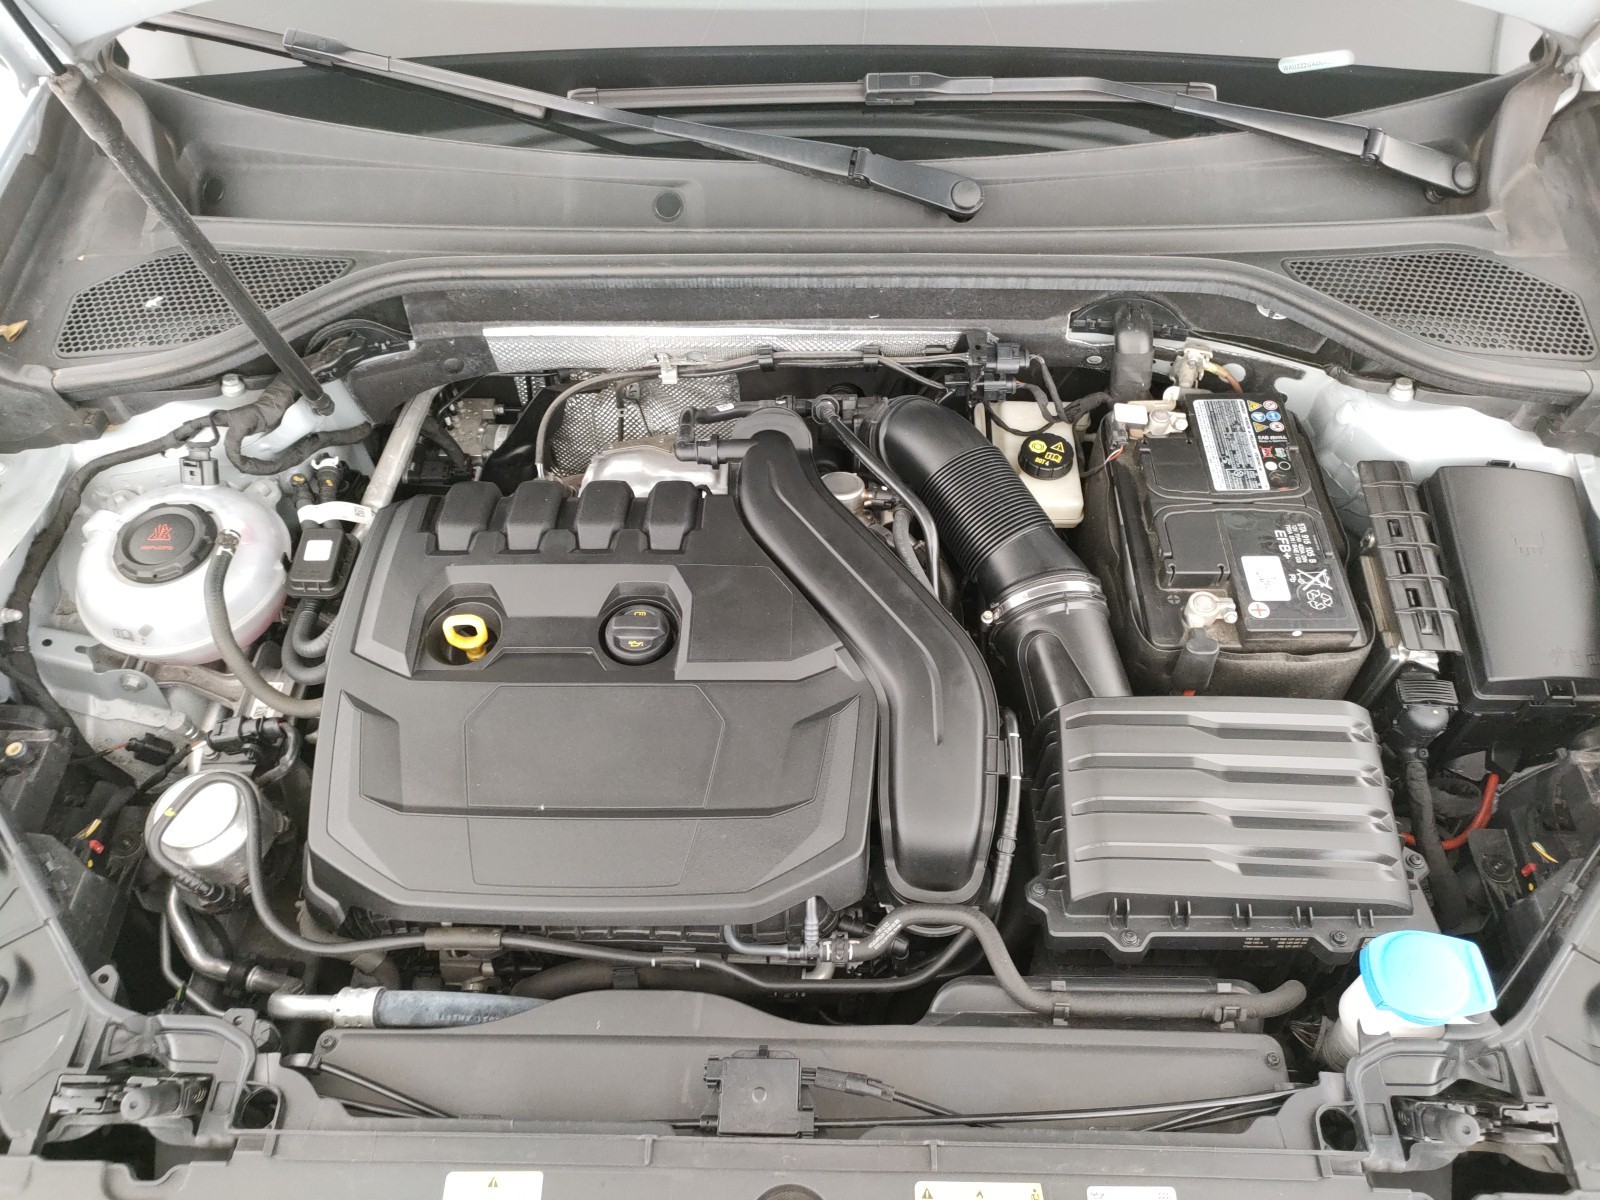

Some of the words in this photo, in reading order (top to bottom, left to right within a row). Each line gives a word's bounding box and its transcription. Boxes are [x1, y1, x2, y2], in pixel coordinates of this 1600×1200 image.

[1274, 529, 1292, 559] EFB+
[1301, 534, 1311, 544] 915
[1305, 547, 1315, 557] 105
